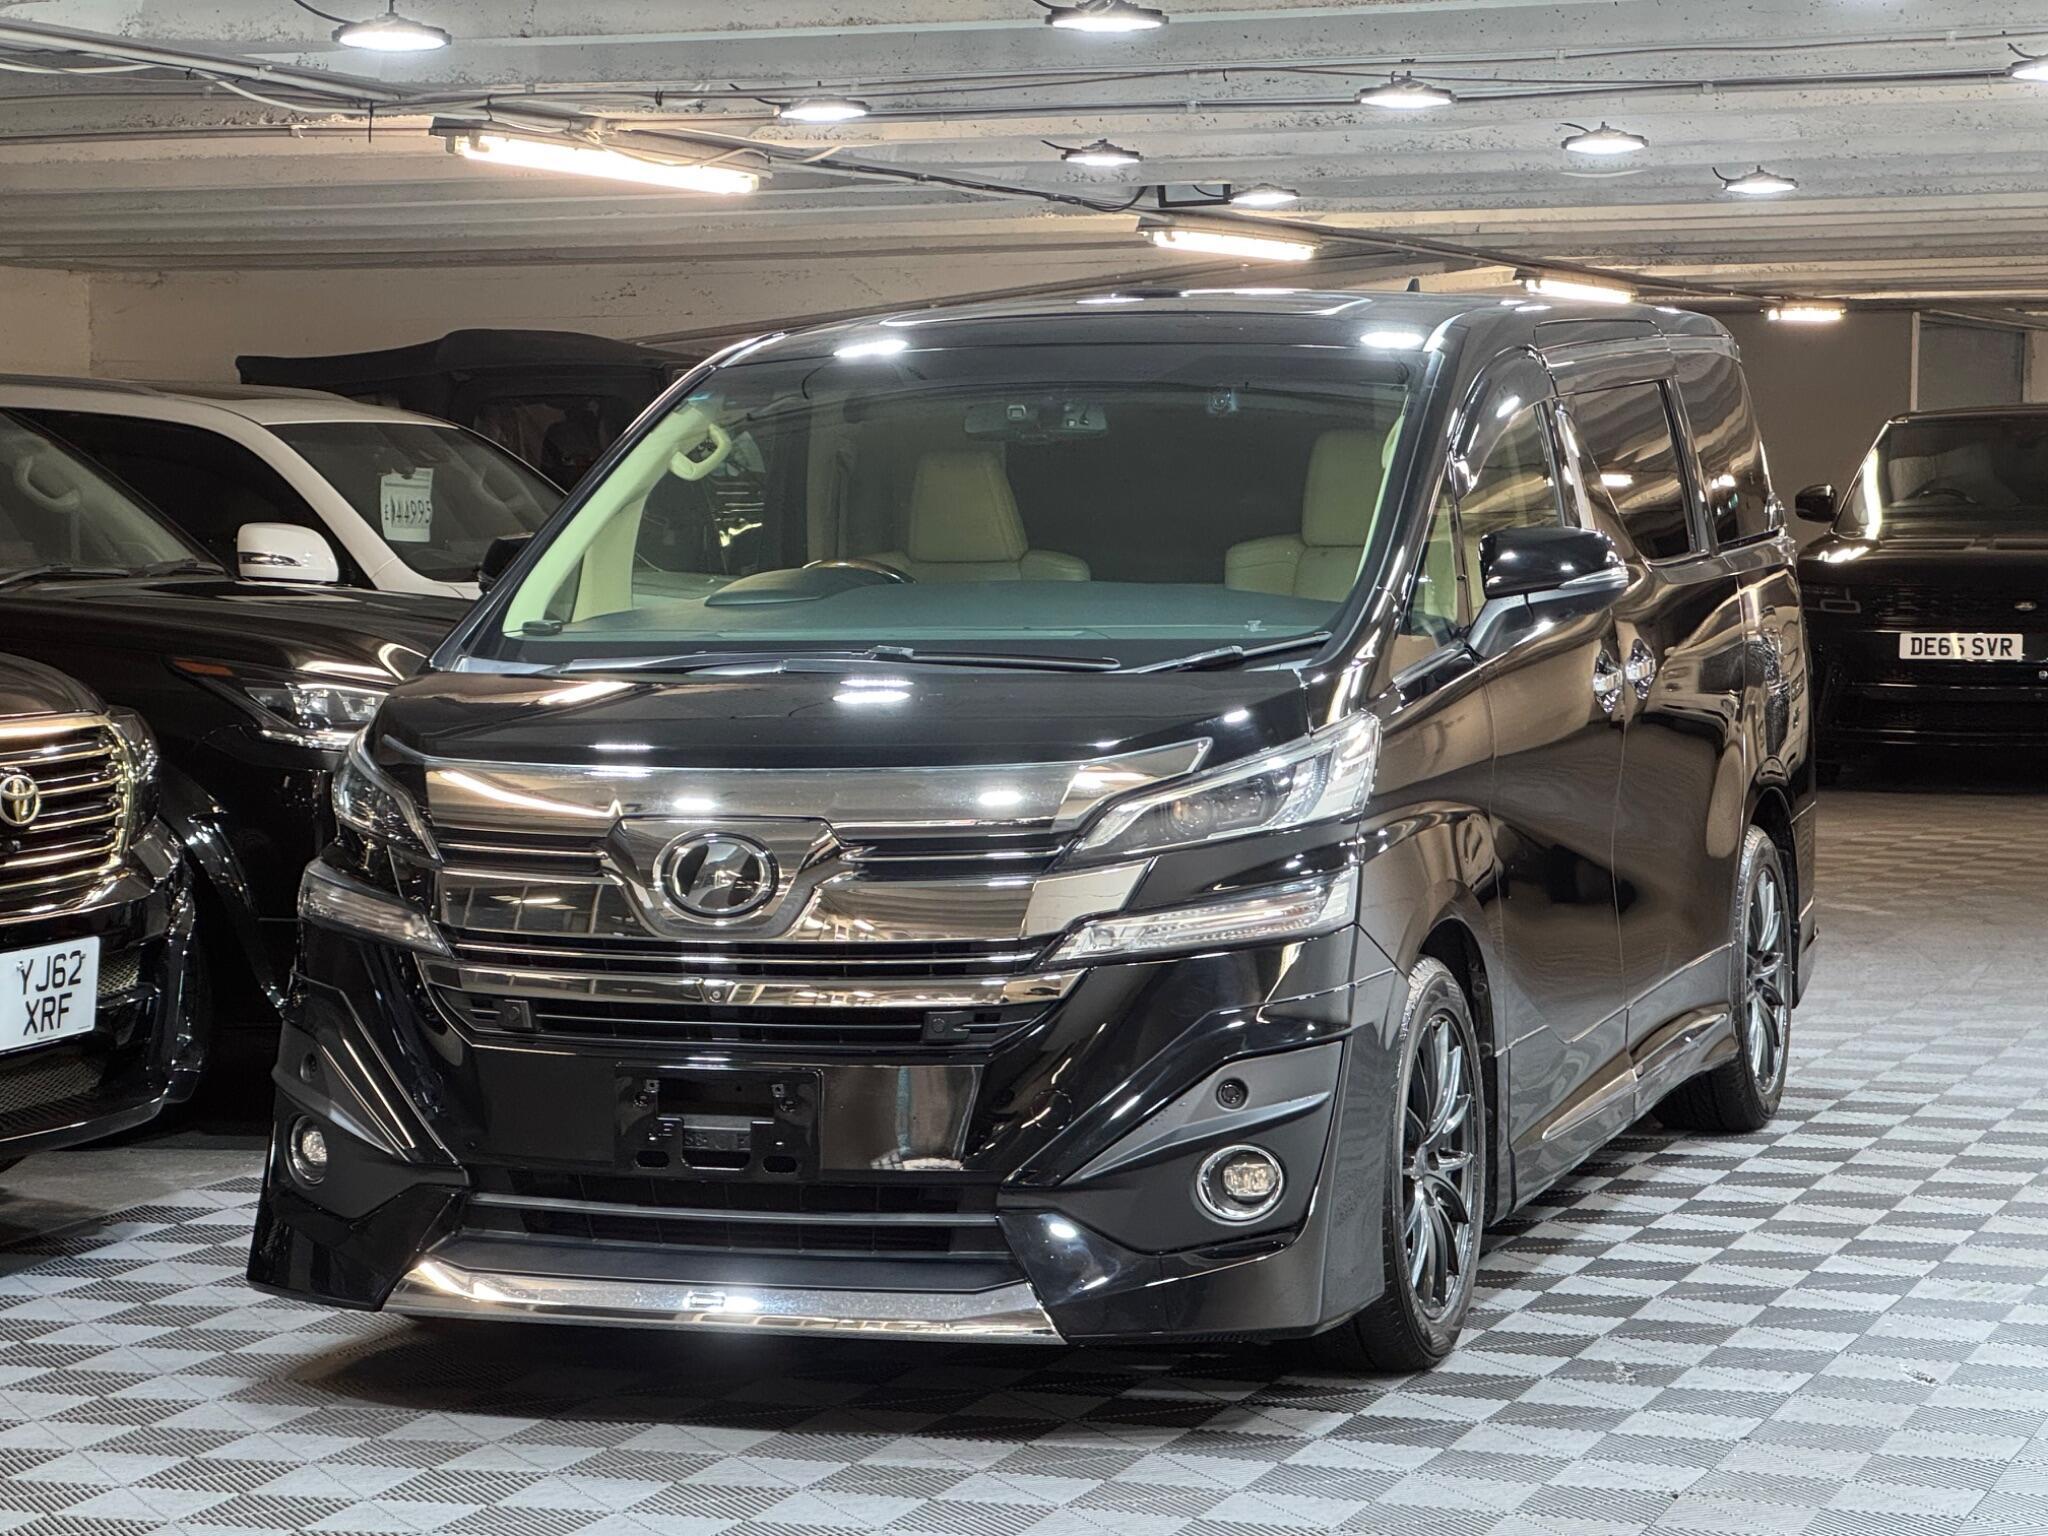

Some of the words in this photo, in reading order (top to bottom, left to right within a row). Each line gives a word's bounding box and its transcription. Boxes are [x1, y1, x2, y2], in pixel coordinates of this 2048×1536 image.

[1972, 638, 2013, 656] SVR
[20, 950, 83, 995] YJ62
[23, 992, 73, 1036] XRF
